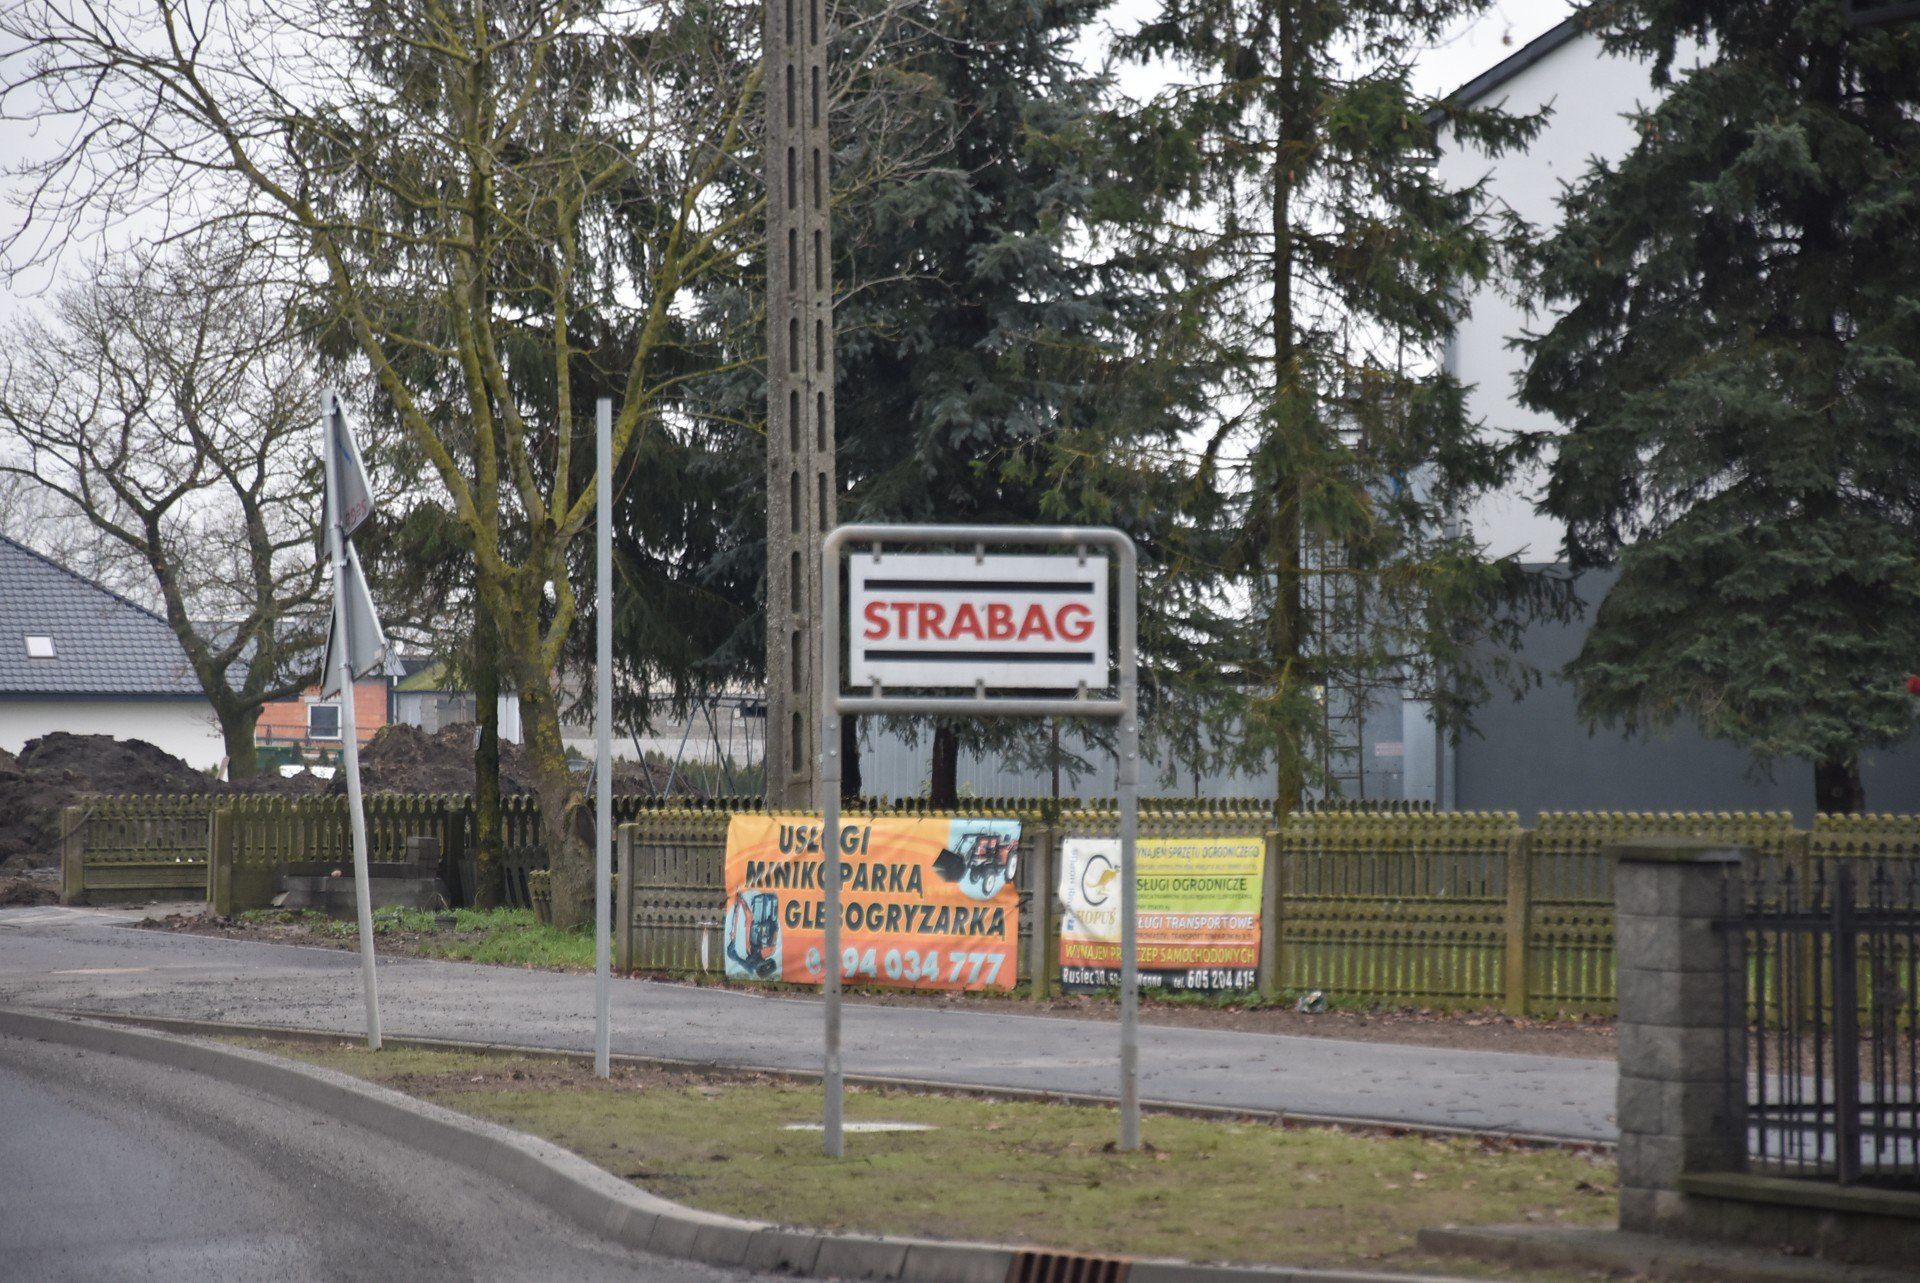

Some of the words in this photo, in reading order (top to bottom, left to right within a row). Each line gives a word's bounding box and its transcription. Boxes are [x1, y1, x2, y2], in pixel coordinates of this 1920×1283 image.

[863, 601, 1095, 643] STRABAG
[1136, 846, 1167, 858] YNAJEM
[1136, 878, 1169, 892] SŁUGI
[1172, 878, 1248, 892] OGRODNICZE
[784, 900, 1006, 942] GLEOGRYZARKĄ
[1137, 916, 1163, 929] ŁUGI
[1165, 916, 1254, 930] TRANSPORTOWE
[1110, 946, 1158, 963] PRCZEP
[1160, 947, 1255, 964] SAMOCHODOWYCH
[841, 947, 877, 979] 94
[885, 949, 940, 982] 034
[949, 951, 1006, 985] 777
[1062, 967, 1094, 984] Rusiec
[1187, 969, 1210, 989] 605
[1211, 970, 1233, 990] 204
